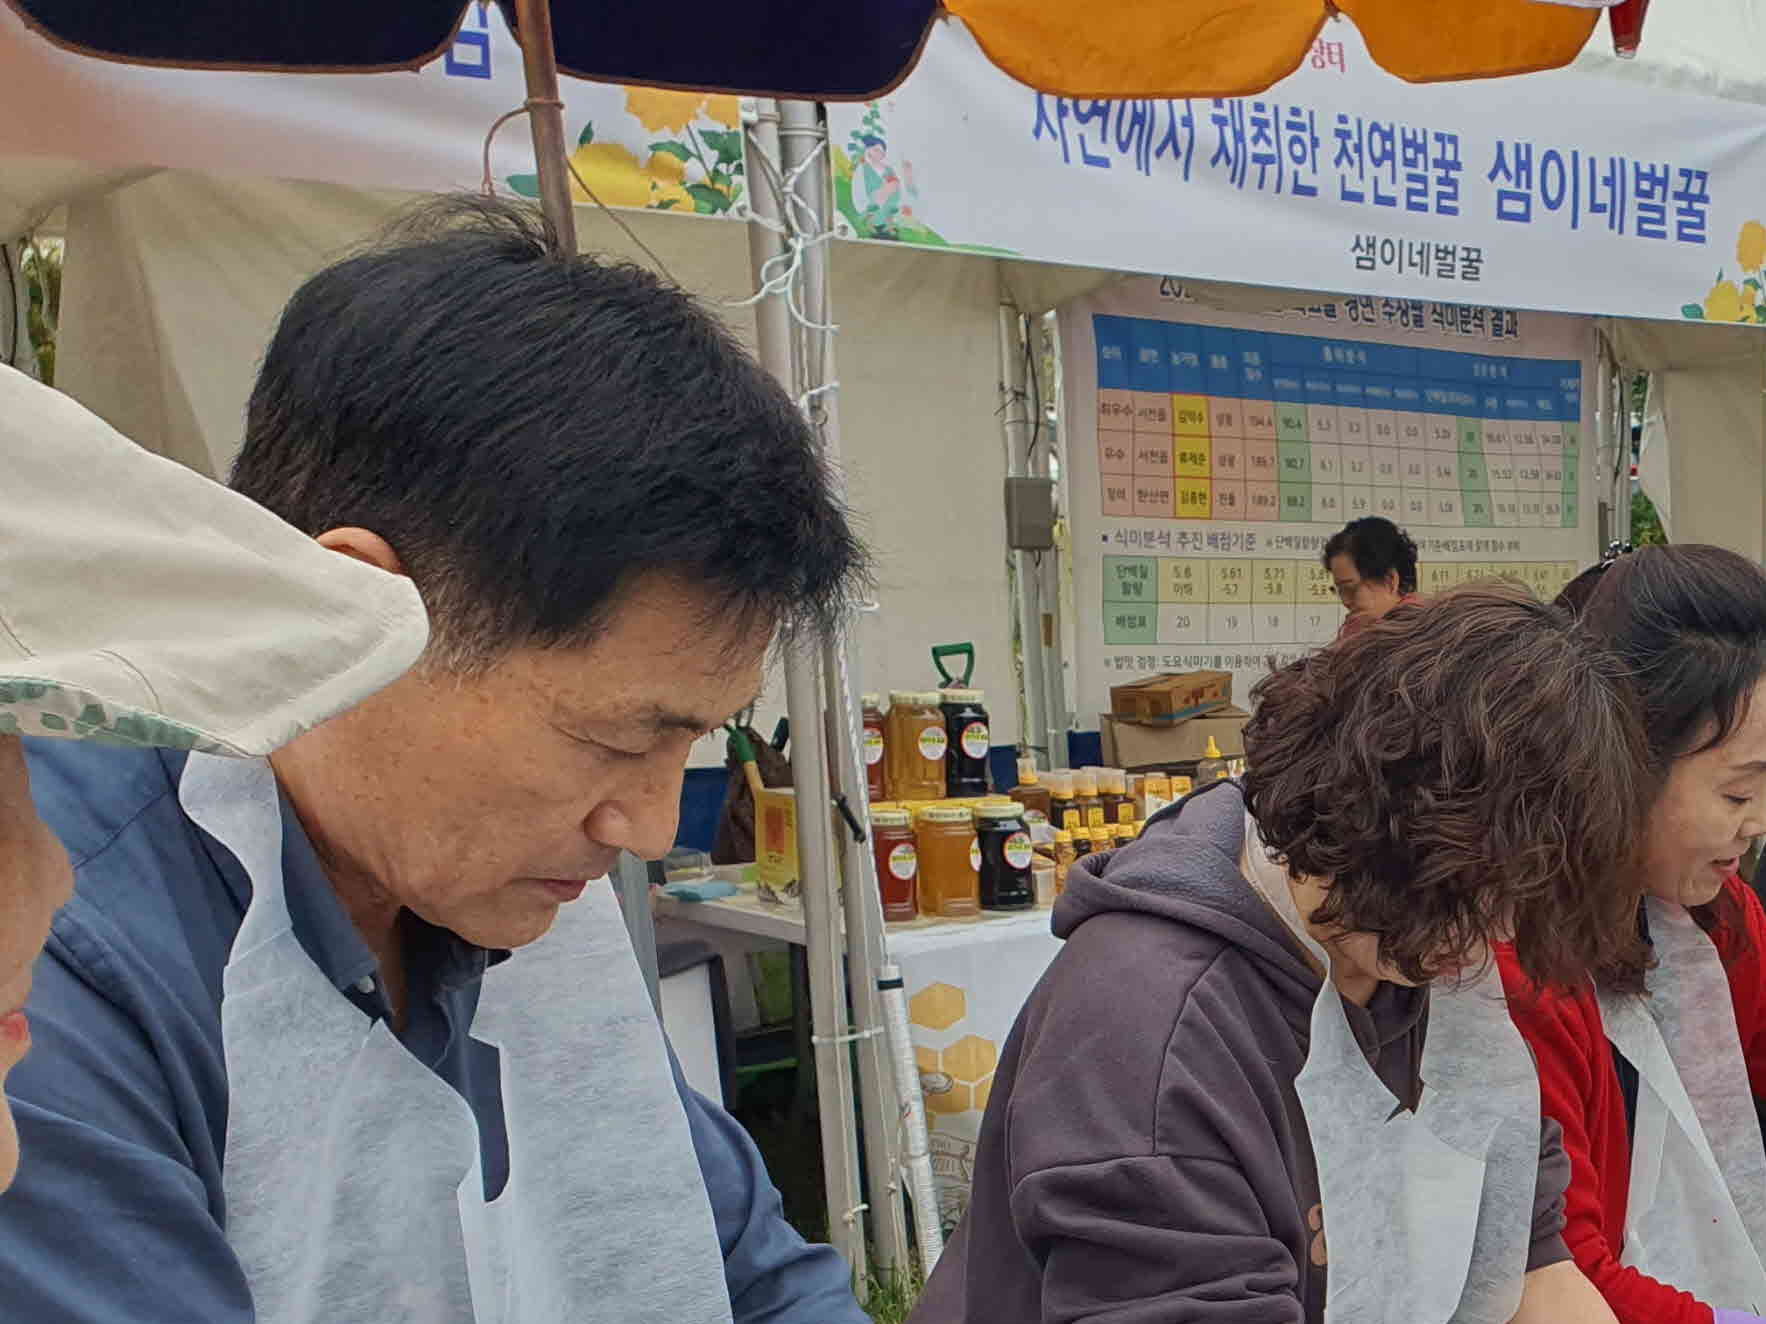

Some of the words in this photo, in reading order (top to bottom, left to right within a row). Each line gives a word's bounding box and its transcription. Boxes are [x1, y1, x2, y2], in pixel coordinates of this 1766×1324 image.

[1210, 98, 1320, 198] 채취한
[1333, 112, 1464, 218] 천연벌꿀
[1487, 140, 1711, 245] 샘이네벌꿀
[1351, 234, 1484, 282] 샘이네벌꿀
[1114, 528, 1171, 549] 식미분석
[1175, 530, 1204, 550] 추진
[1175, 615, 1191, 629] 20
